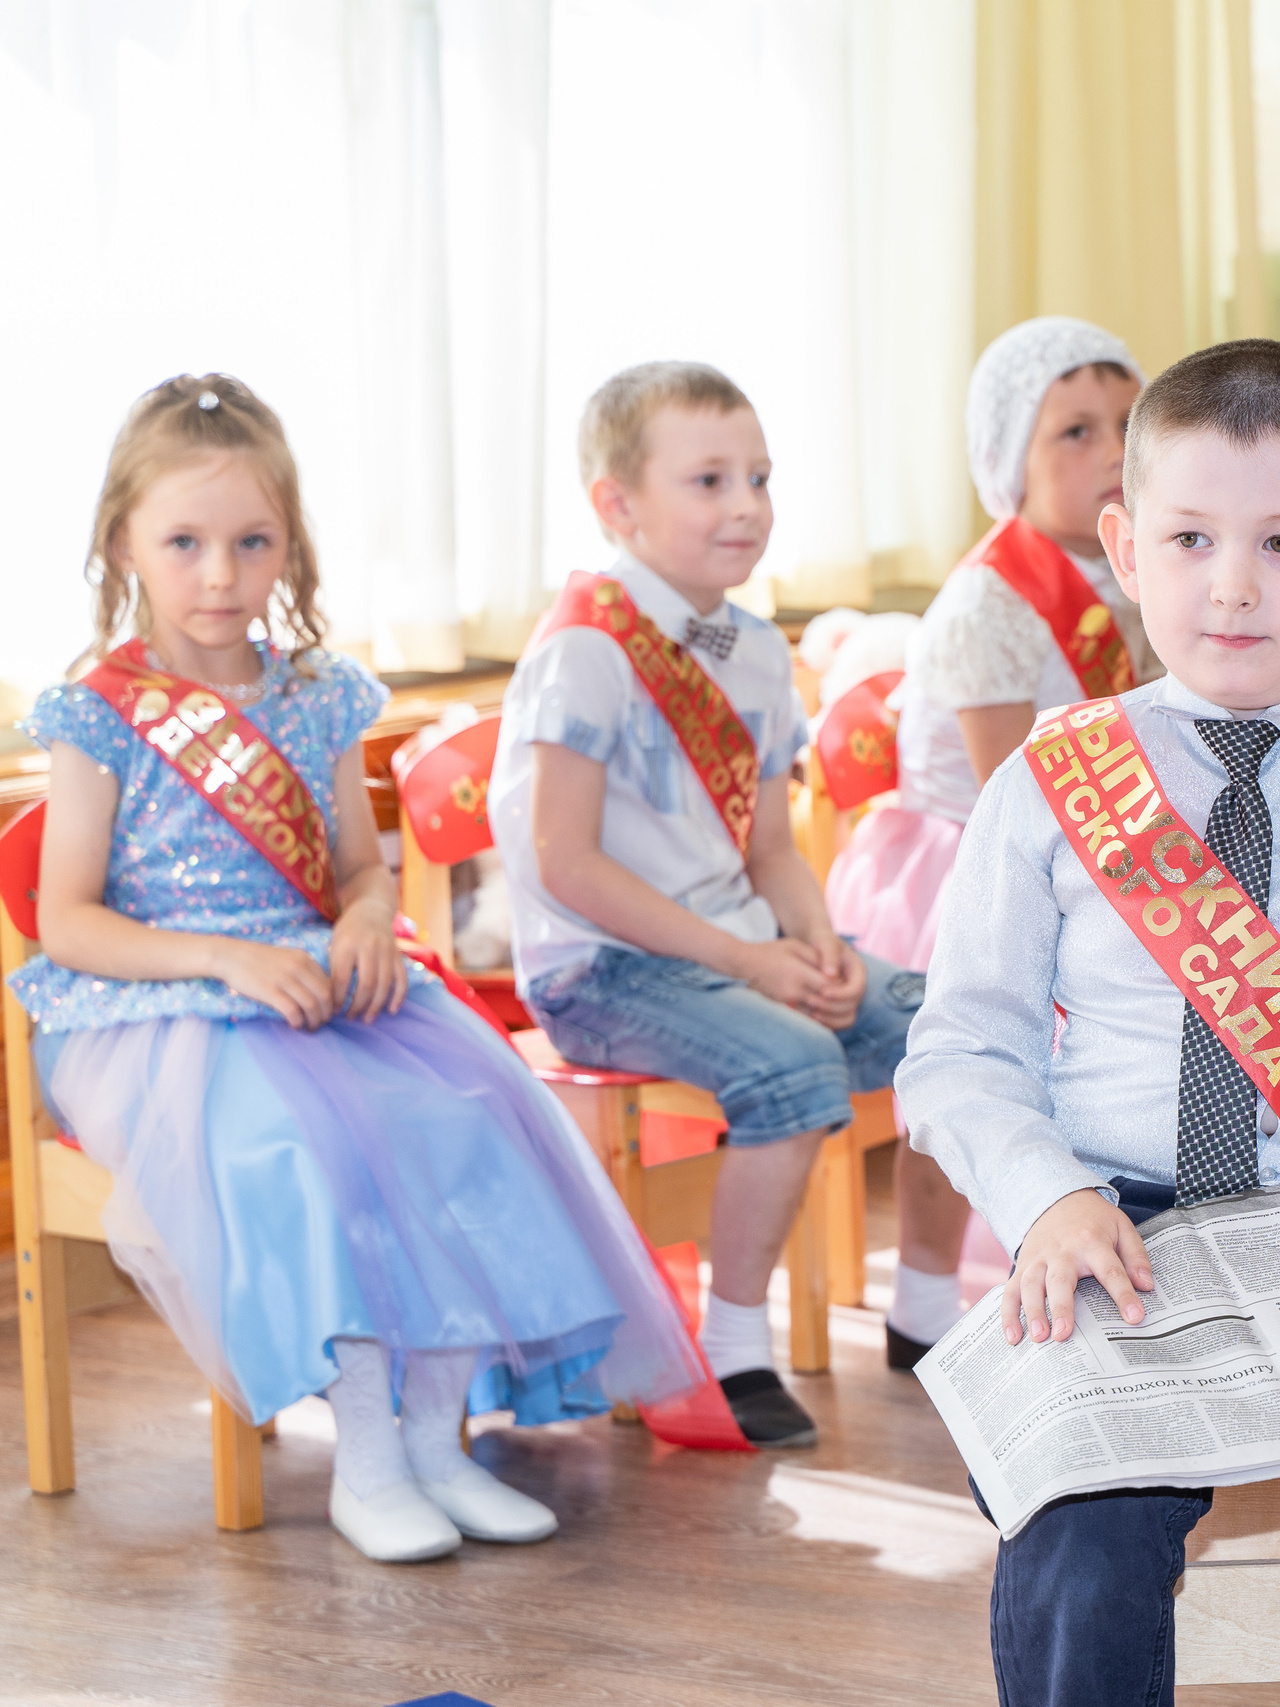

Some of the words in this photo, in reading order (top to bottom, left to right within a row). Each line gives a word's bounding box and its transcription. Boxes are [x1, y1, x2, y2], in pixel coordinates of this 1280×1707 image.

[1028, 720, 1182, 937] ДЕТСКОГО
[994, 1386, 1106, 1461] Комплексный
[1111, 1379, 1179, 1394] подход
[1182, 1378, 1193, 1386] к
[1198, 1364, 1275, 1387] ремонту
[1136, 1391, 1170, 1402] Кузбассе
[1170, 1388, 1206, 1396] приведут
[1213, 1384, 1246, 1394] порядок
